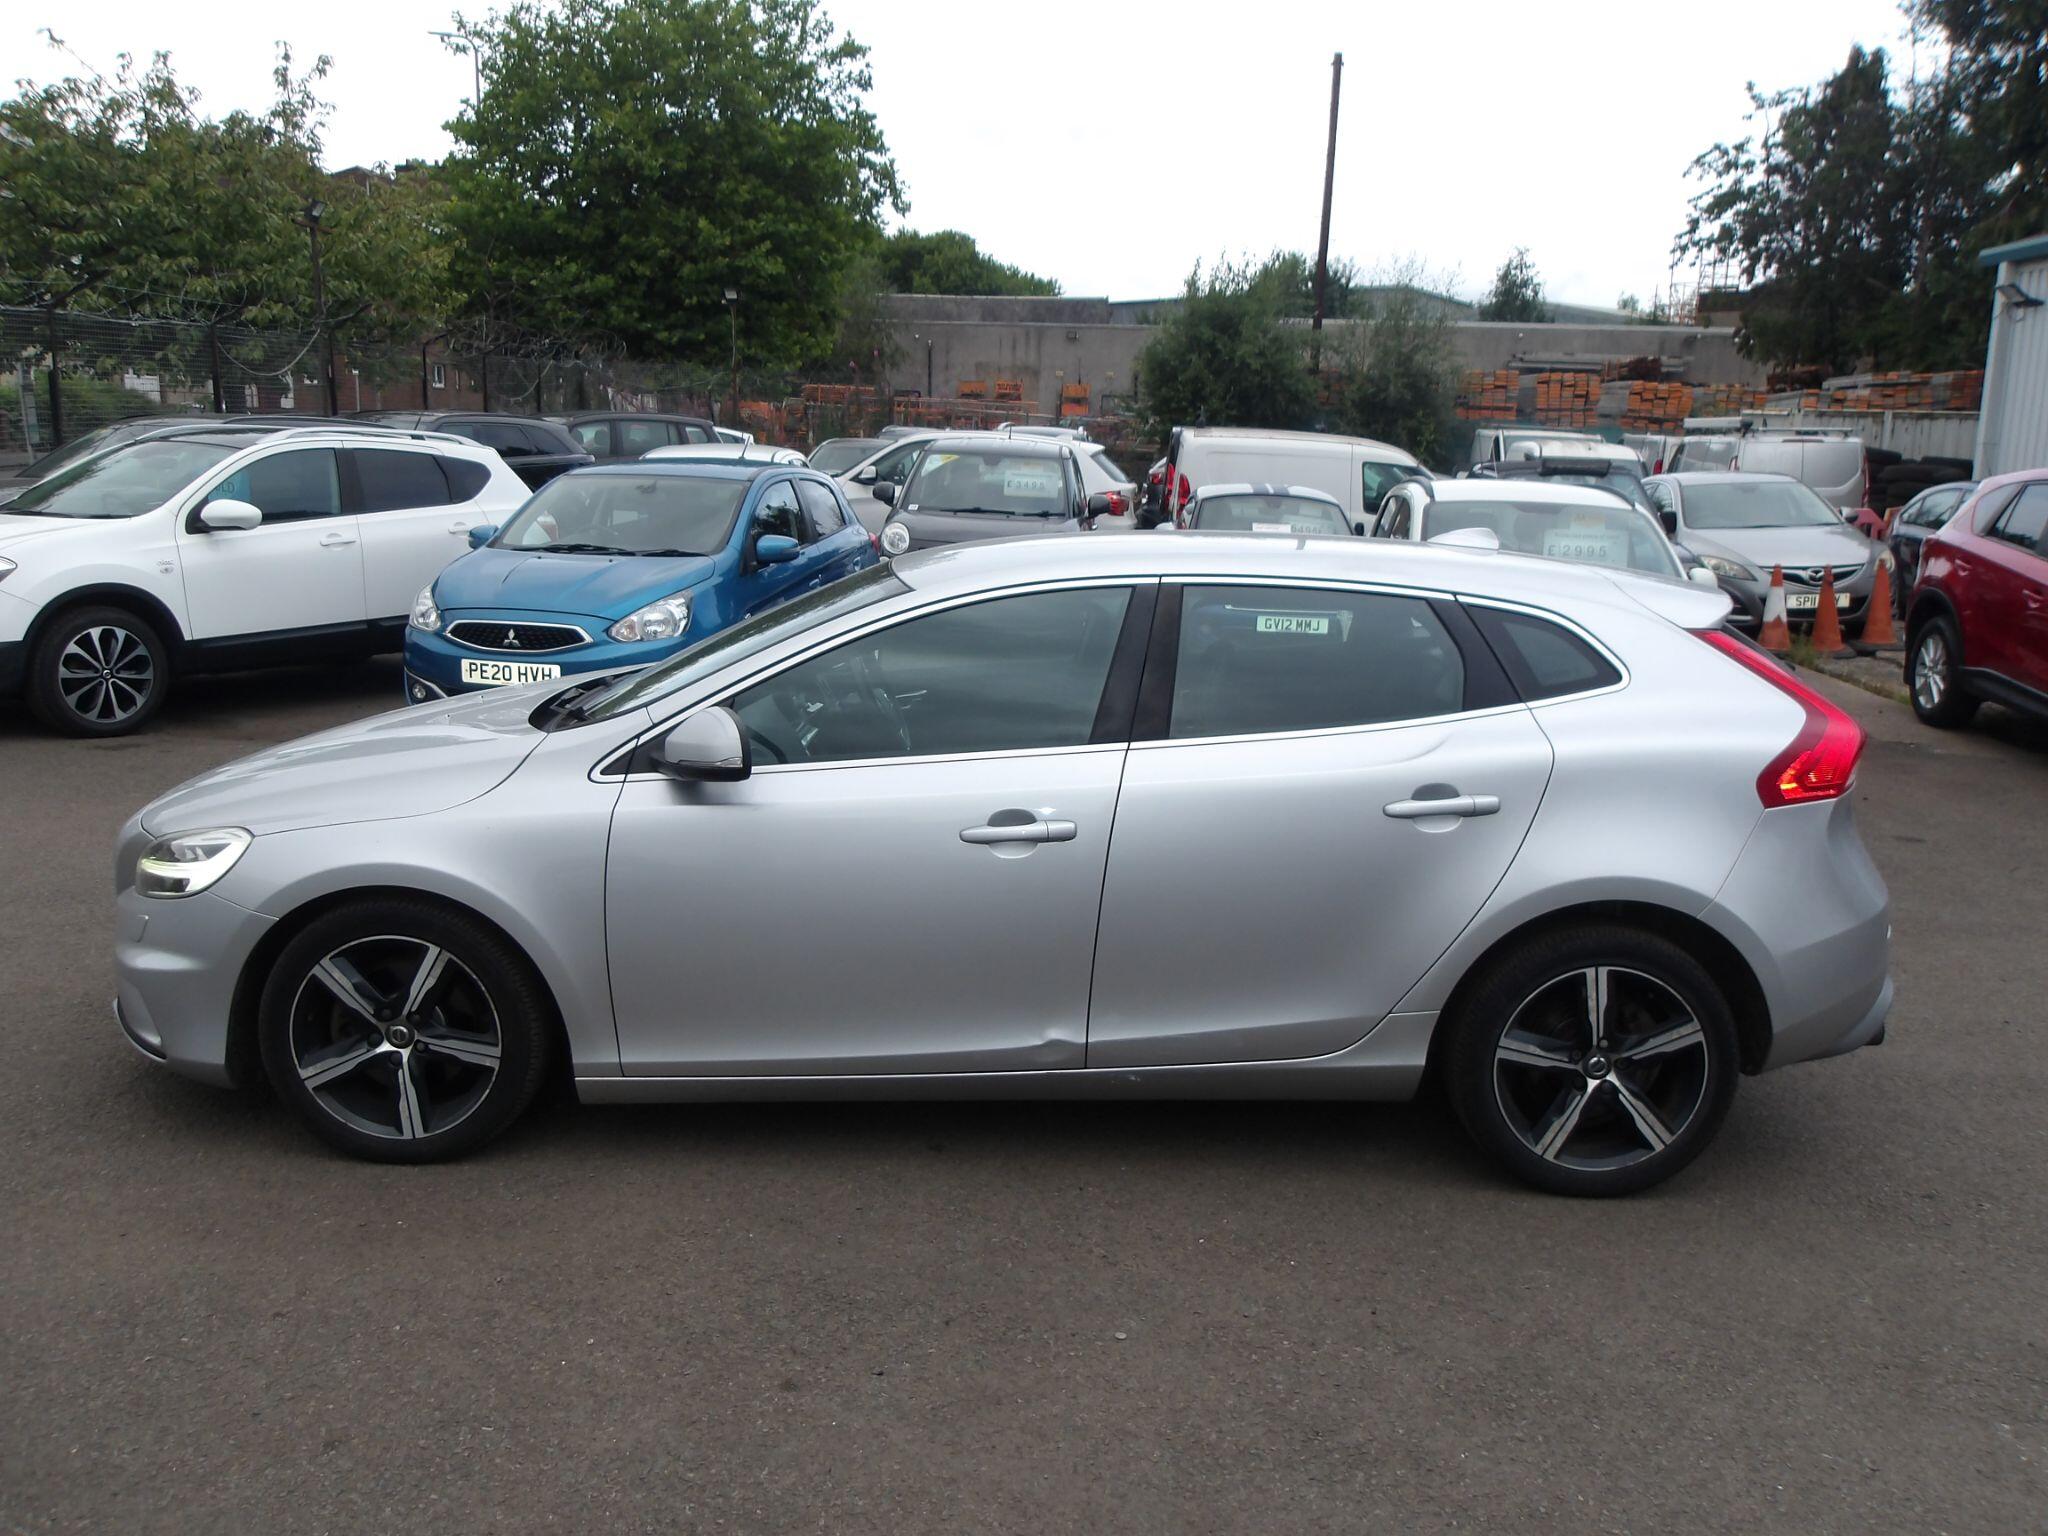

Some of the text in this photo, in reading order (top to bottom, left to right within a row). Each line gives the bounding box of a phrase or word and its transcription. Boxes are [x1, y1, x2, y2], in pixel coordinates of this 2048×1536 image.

[1264, 618, 1320, 631] GV12 MMJ
[469, 662, 552, 682] PE20 HVH
